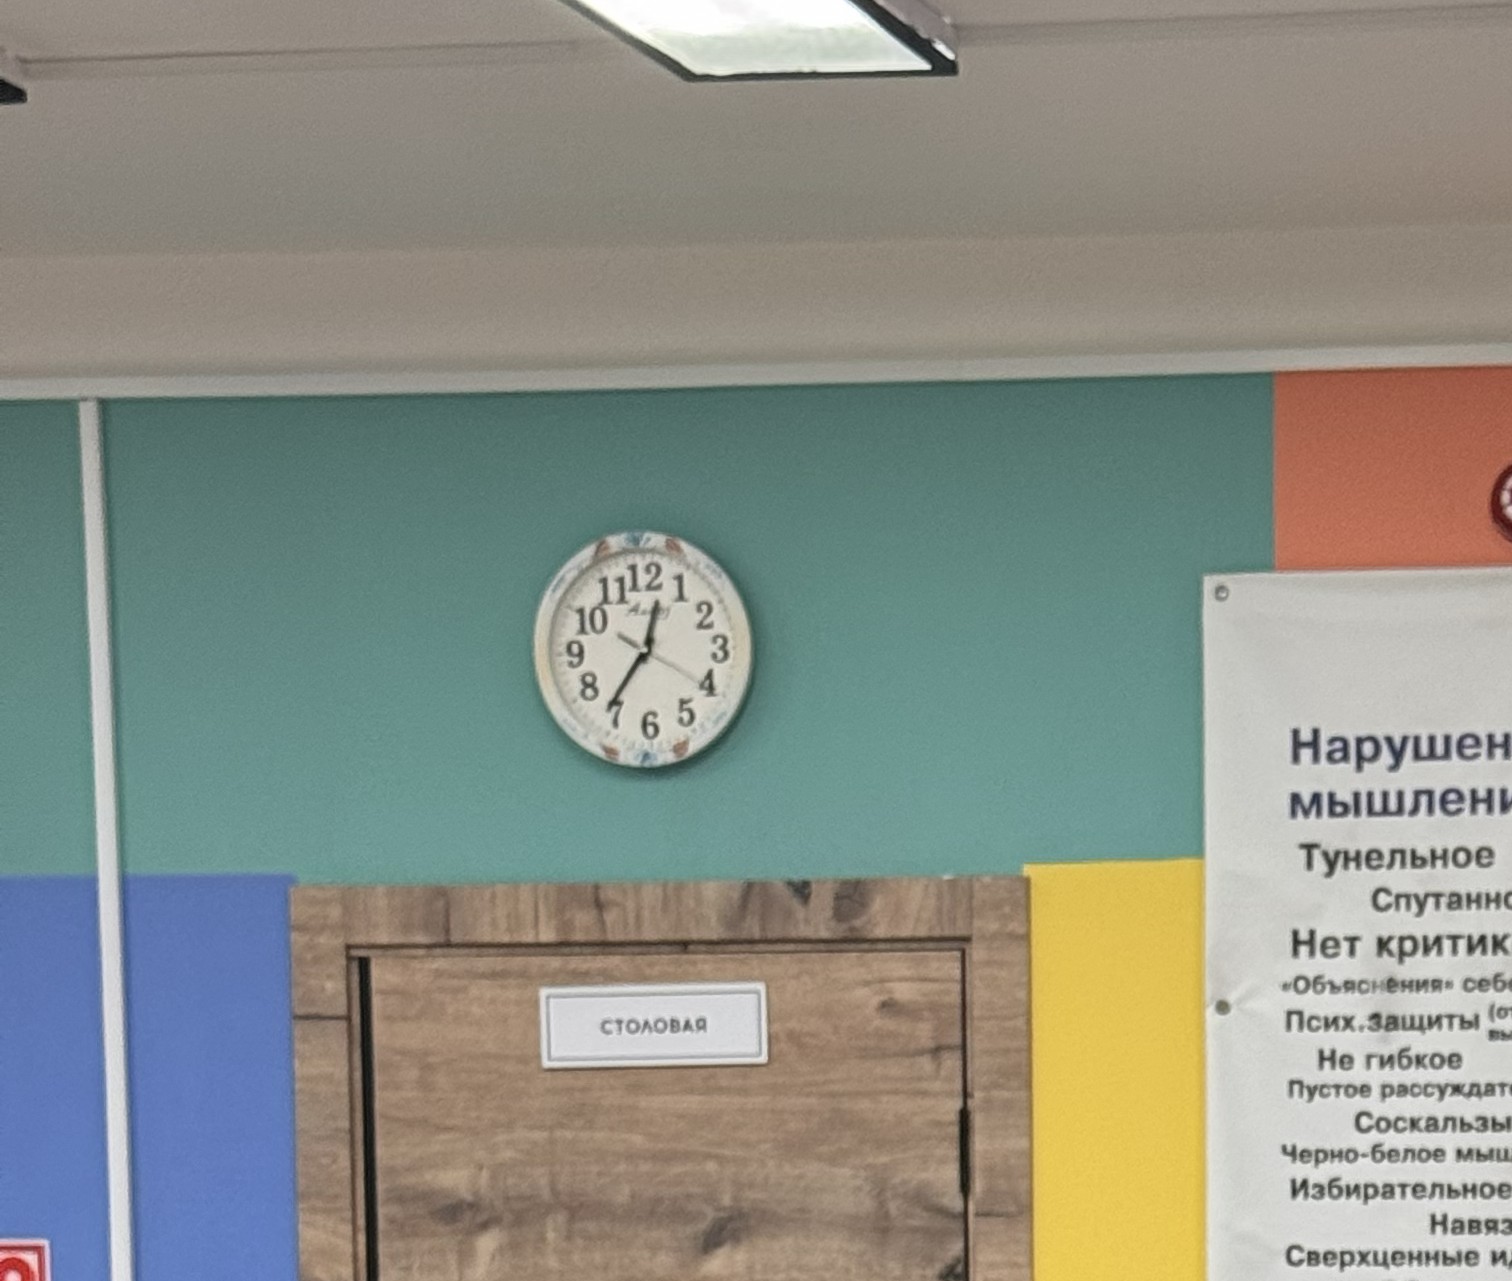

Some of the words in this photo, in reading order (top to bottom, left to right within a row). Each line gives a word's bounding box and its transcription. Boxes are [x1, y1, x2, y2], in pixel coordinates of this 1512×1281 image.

[627, 561, 663, 592] 12
[673, 574, 689, 601] 1
[600, 577, 628, 604] 11
[576, 608, 608, 635] 10
[697, 602, 714, 630] 2
[566, 641, 586, 669] 9
[712, 636, 730, 663] 3
[580, 673, 600, 699] 8
[700, 669, 717, 697] 4
[609, 701, 624, 728] 7
[641, 711, 660, 740] 6
[678, 699, 696, 727] 5
[1298, 843, 1495, 878] Тунельное
[1292, 929, 1361, 959] Нет
[600, 1017, 707, 1035] СТОЛОВАЯ
[1318, 1048, 1354, 1071] Не
[1365, 1046, 1462, 1070] гибкое
[1288, 1079, 1372, 1103] Пустое
[1281, 1143, 1446, 1168] Черно-белое
[1290, 1177, 1512, 1205] Избирательное
[1285, 1244, 1480, 1272] Сверхценные
